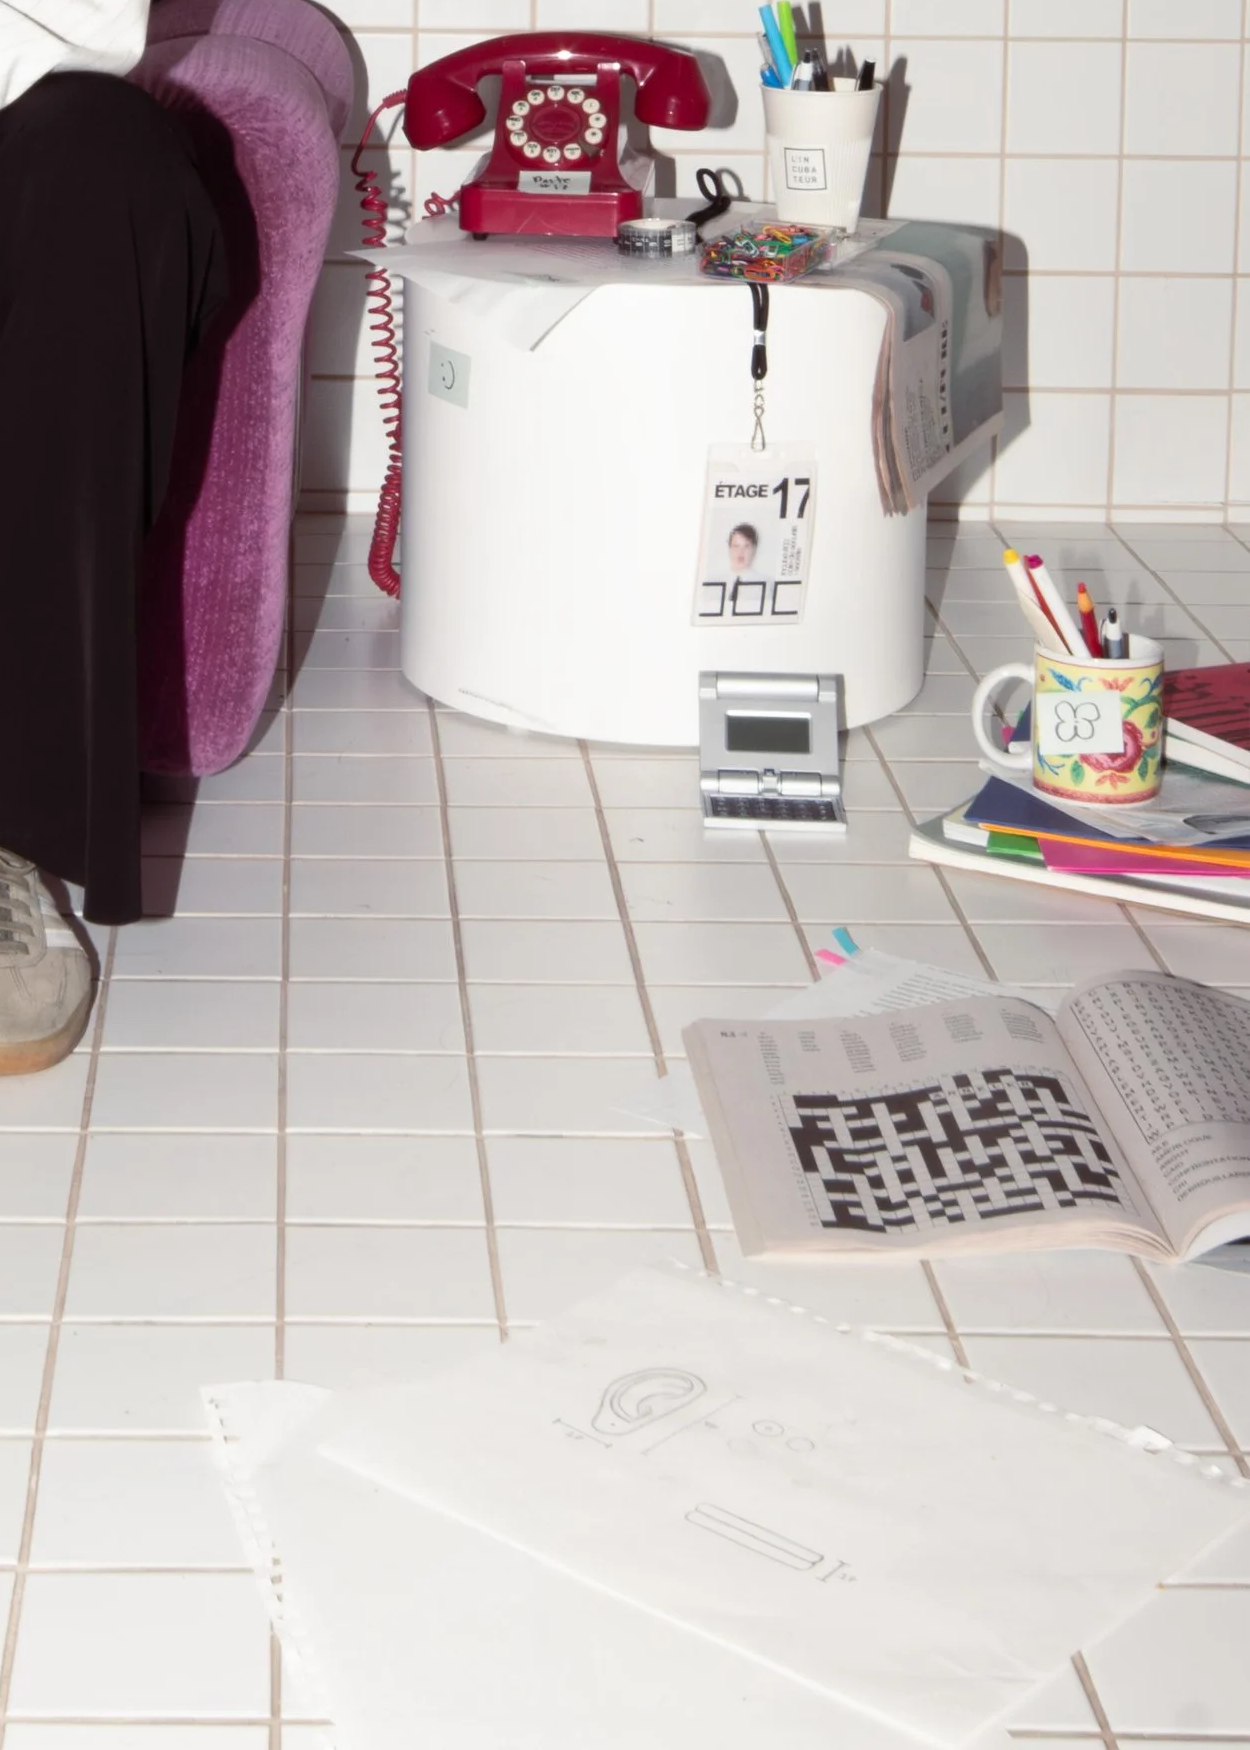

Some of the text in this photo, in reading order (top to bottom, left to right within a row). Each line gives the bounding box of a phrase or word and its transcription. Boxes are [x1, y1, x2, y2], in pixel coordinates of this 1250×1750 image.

[791, 165, 817, 173] CUBA
[714, 477, 811, 519] ÉTAGE 17
